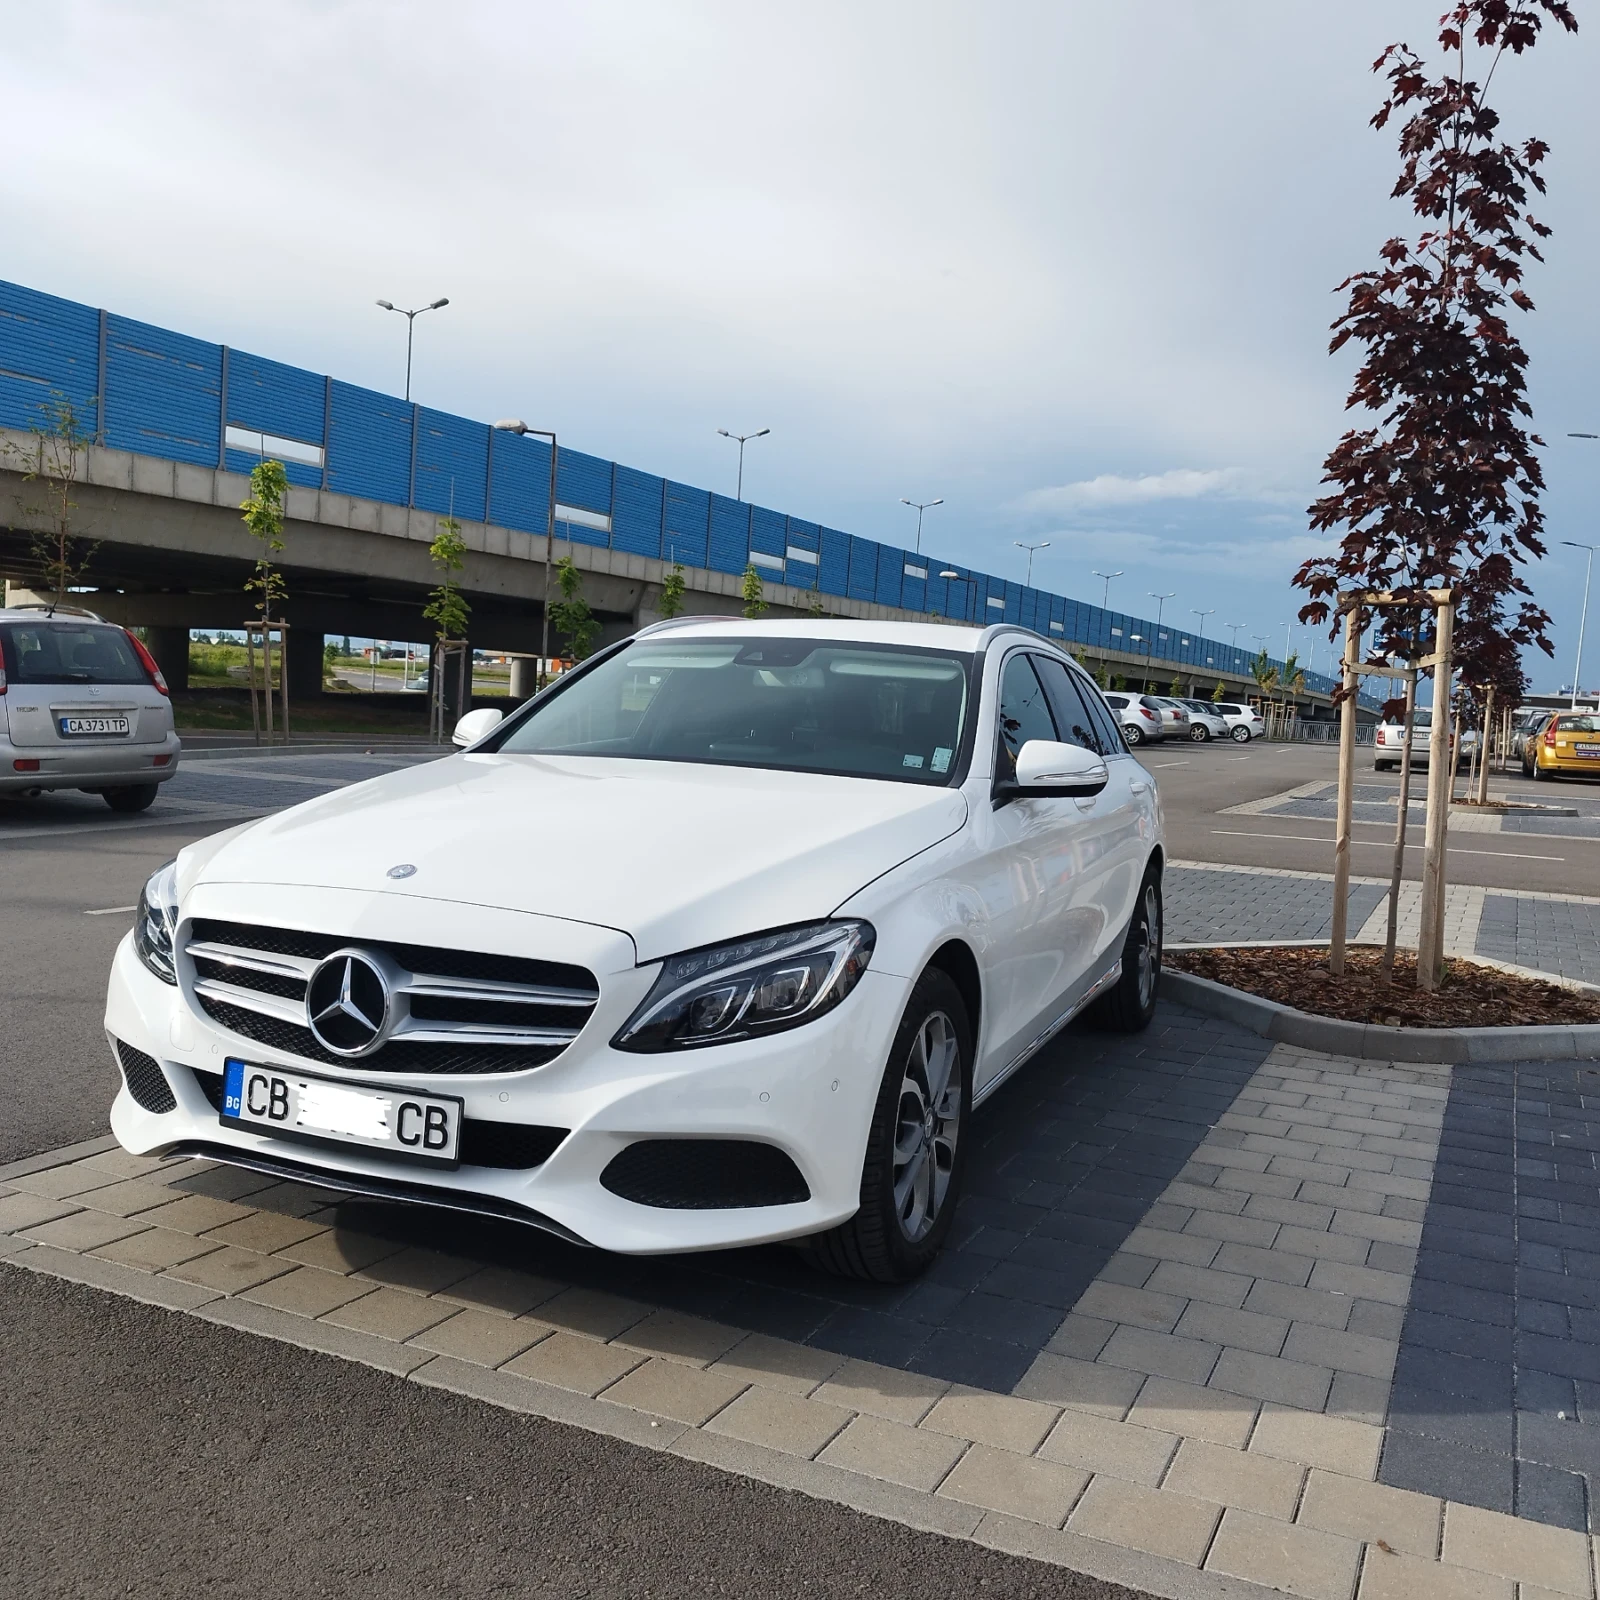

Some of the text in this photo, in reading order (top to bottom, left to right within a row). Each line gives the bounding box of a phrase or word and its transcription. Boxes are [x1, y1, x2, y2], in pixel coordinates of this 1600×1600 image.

[226, 1095, 240, 1110] BG
[247, 1074, 289, 1120] CB
[396, 1101, 449, 1150] CB
